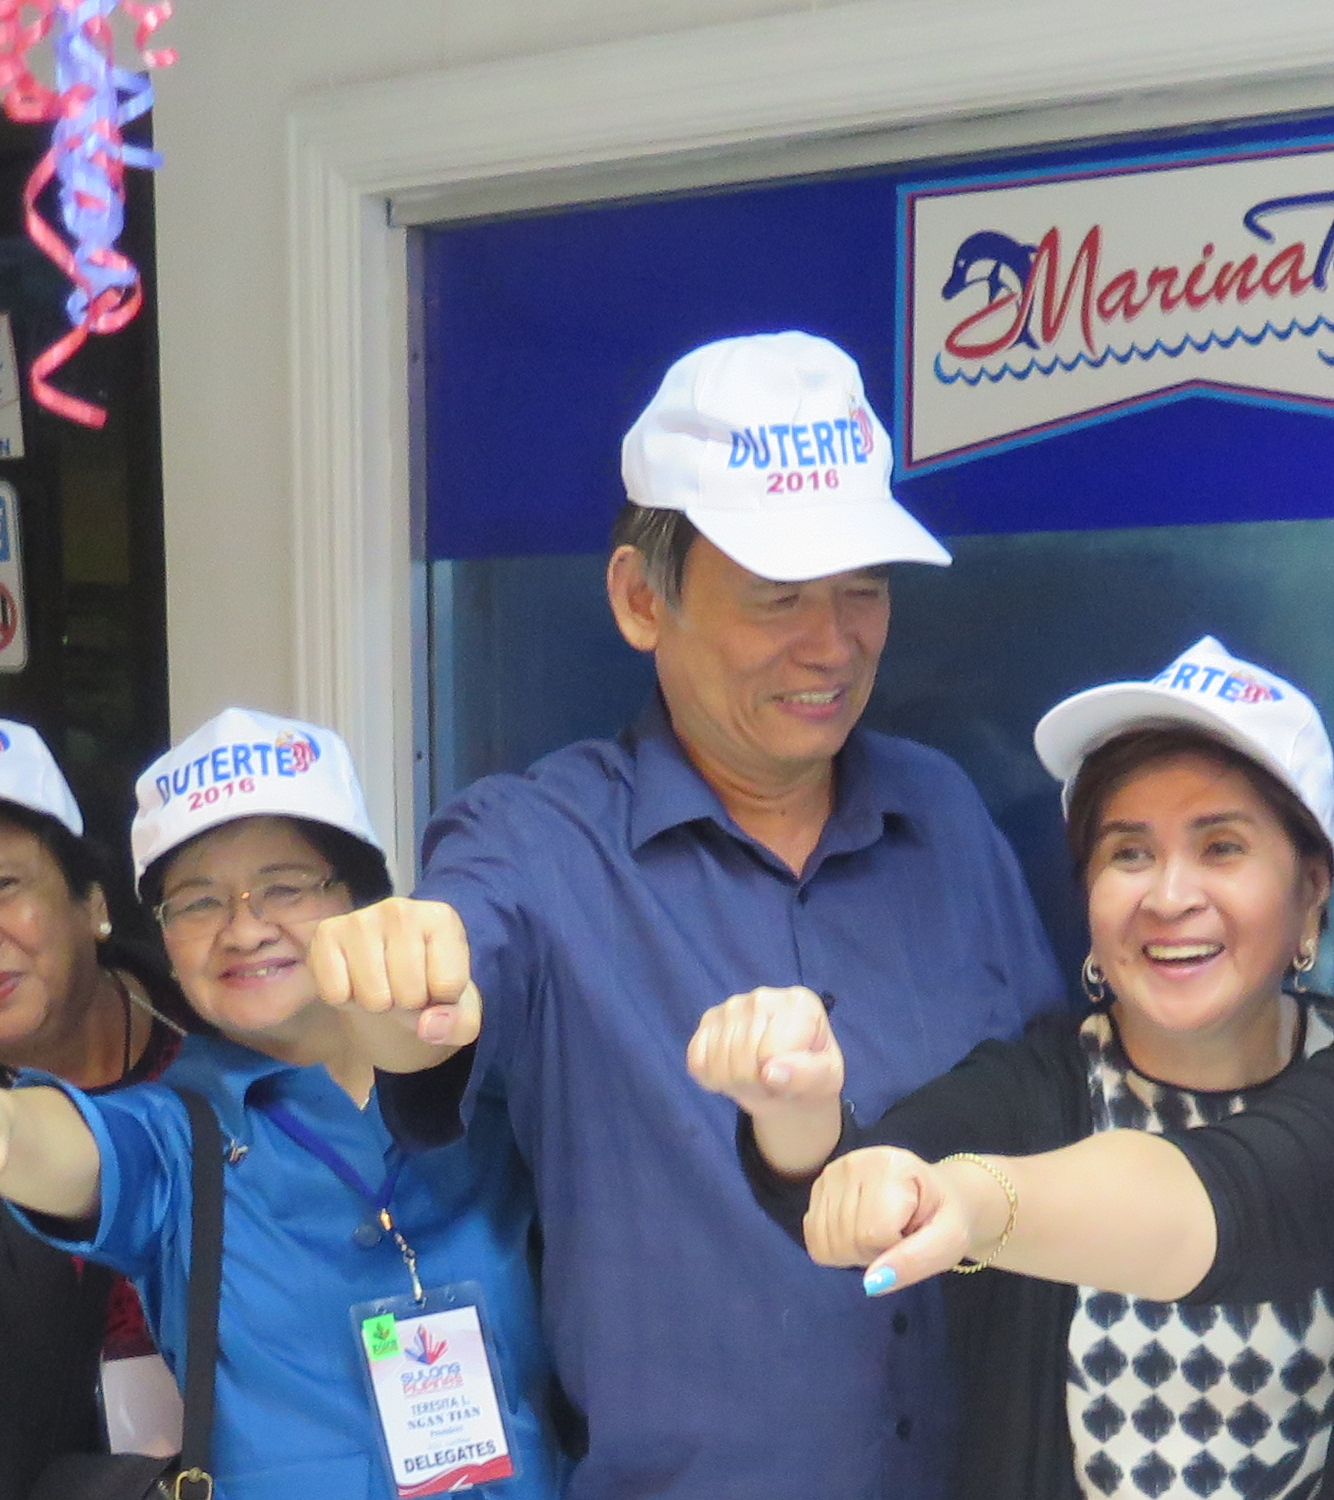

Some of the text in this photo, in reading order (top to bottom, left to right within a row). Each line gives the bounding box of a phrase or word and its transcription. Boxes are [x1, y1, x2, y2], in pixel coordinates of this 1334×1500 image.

[728, 417, 867, 470] DUTERTE
[767, 468, 840, 494] 2016
[156, 741, 297, 806] DUTERTE
[188, 777, 256, 812] 2016
[404, 1439, 497, 1475] DELEGATES
